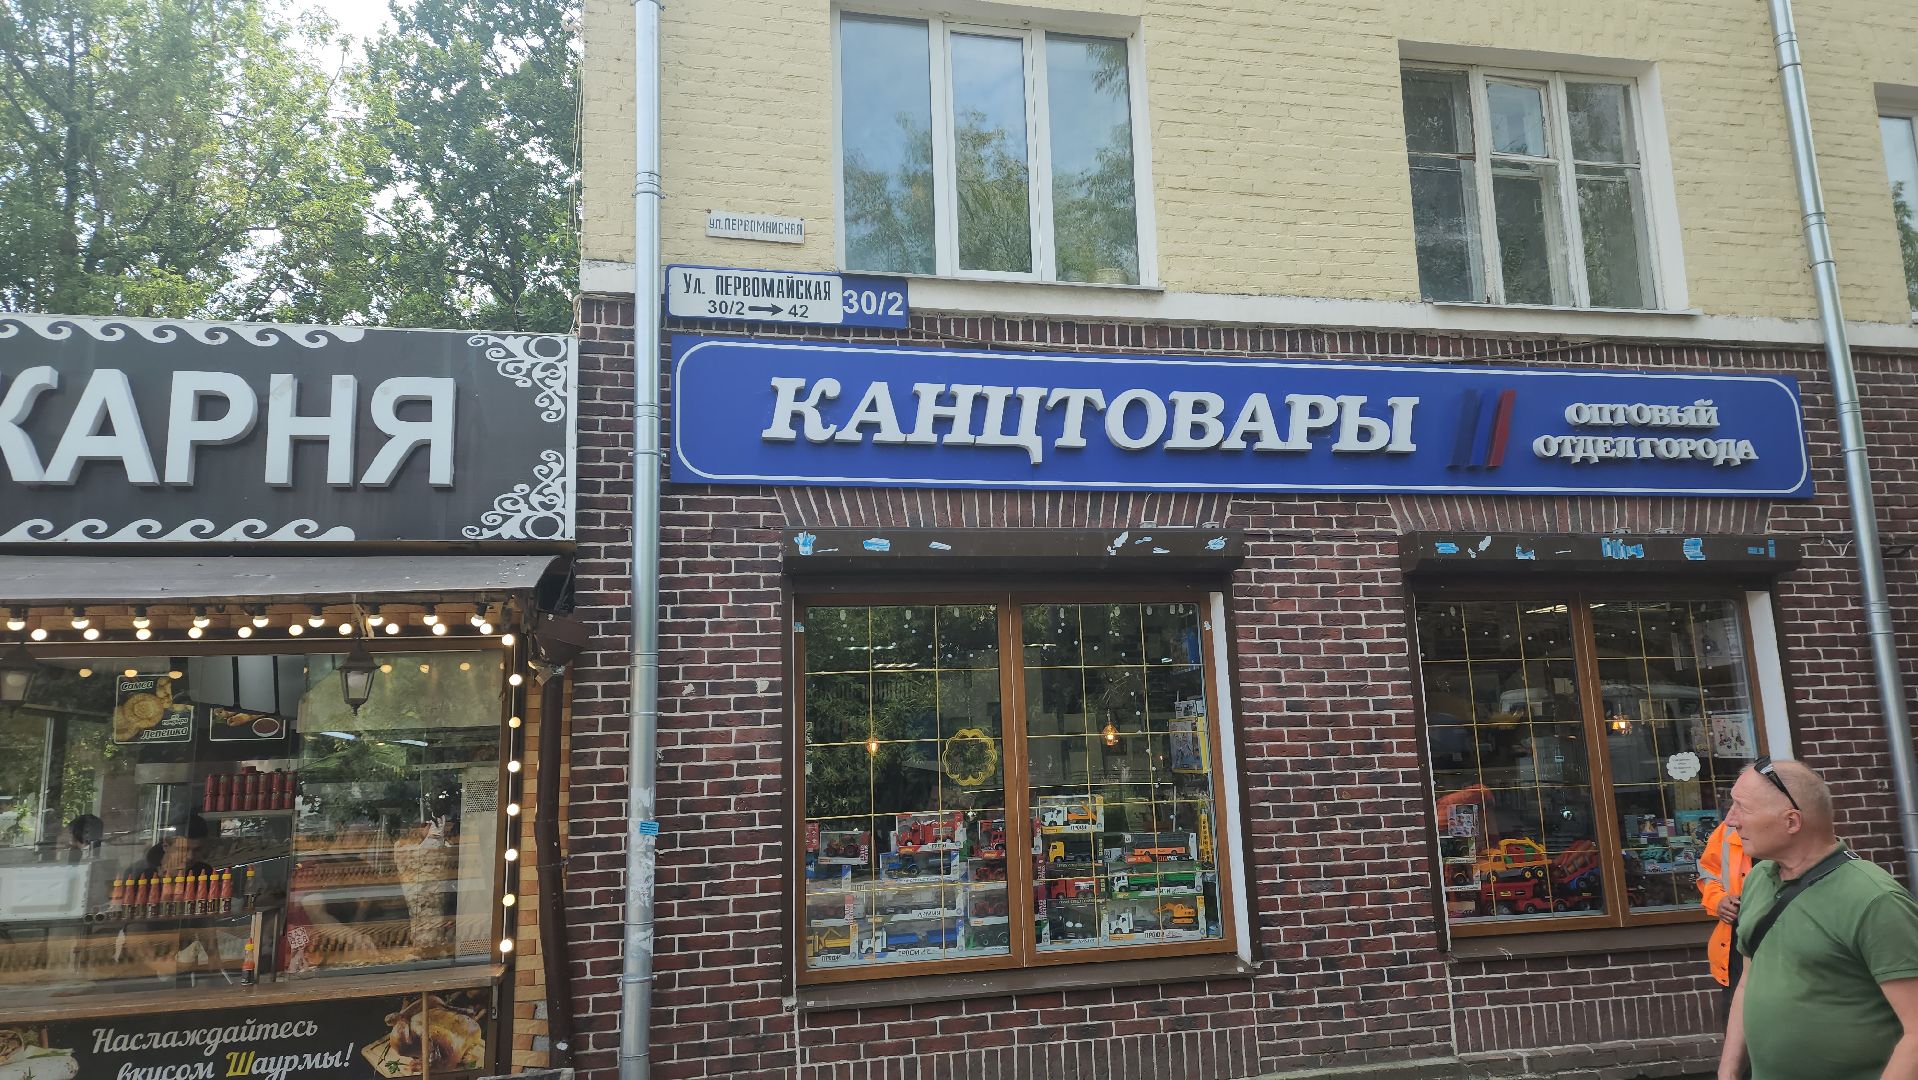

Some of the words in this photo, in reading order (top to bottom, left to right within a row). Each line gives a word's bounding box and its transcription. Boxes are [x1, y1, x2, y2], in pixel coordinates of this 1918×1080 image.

[683, 273, 705, 295] Ул.
[715, 275, 831, 300] ПЕРВОМАЙСКАЯ
[707, 300, 745, 316] 30/2
[788, 304, 809, 318] 42
[842, 289, 904, 316] 30/2
[761, 376, 1420, 465] КАНЦТОВАРЫ
[1564, 399, 1720, 428] ОПТОВЫЙ
[1532, 434, 1637, 464] ОТДЕЛ
[1637, 437, 1759, 466] ГОРОДА
[121, 680, 154, 691] Самса
[92, 1018, 319, 1057] Наслаждайтесь
[116, 1061, 215, 1080] вкусом
[225, 1043, 354, 1080] Шаурмы!
